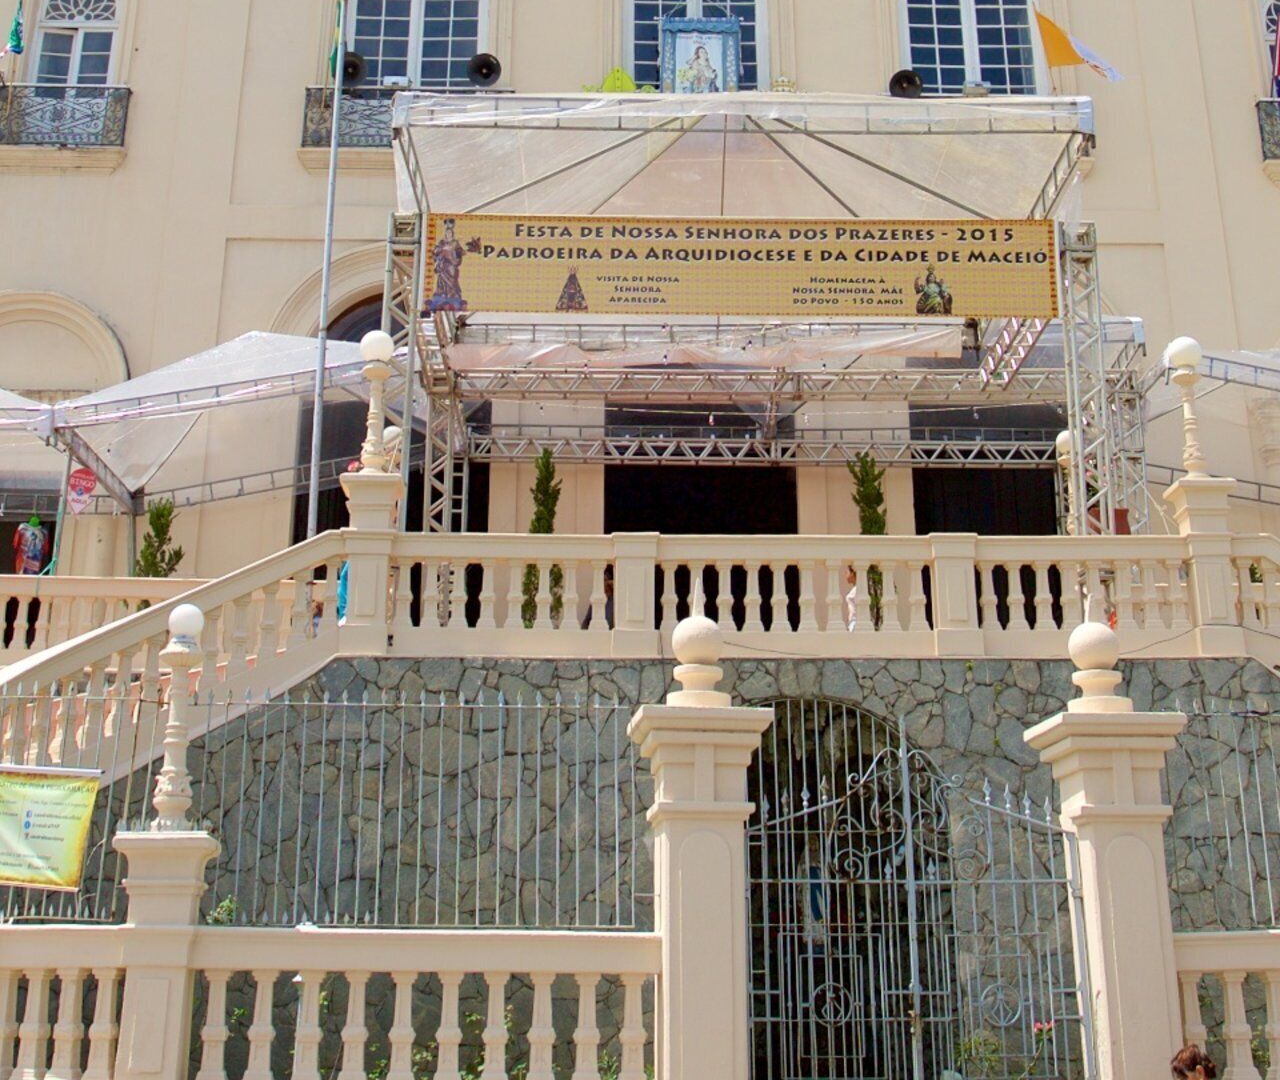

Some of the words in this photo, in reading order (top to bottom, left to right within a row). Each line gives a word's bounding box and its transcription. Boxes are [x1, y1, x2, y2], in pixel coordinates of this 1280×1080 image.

[515, 223, 573, 238] FESTA
[580, 226, 604, 238] DE
[611, 225, 678, 239] NOSSA
[685, 226, 782, 240] SENHORA
[789, 228, 828, 240] DOS
[835, 227, 935, 241] PRAZERES
[956, 228, 1014, 241] 2015
[483, 245, 603, 259] PADROEIRA
[610, 248, 643, 260] DA
[645, 247, 796, 261] ARQUIDIOCESE
[804, 249, 813, 261] E
[821, 250, 848, 261] DA
[854, 249, 929, 262] CIDADE
[937, 251, 960, 263] DE
[967, 248, 1048, 263] MACEIÓ
[647, 275, 680, 283] NOSSA
[810, 276, 876, 284] HOMENAGEM
[614, 285, 662, 293] SENHORA
[828, 286, 875, 295] SENHORA
[609, 295, 667, 303] APARECIDA
[810, 297, 839, 305] POVO
[853, 297, 874, 305] 150
[70, 477, 96, 489] BINGO
